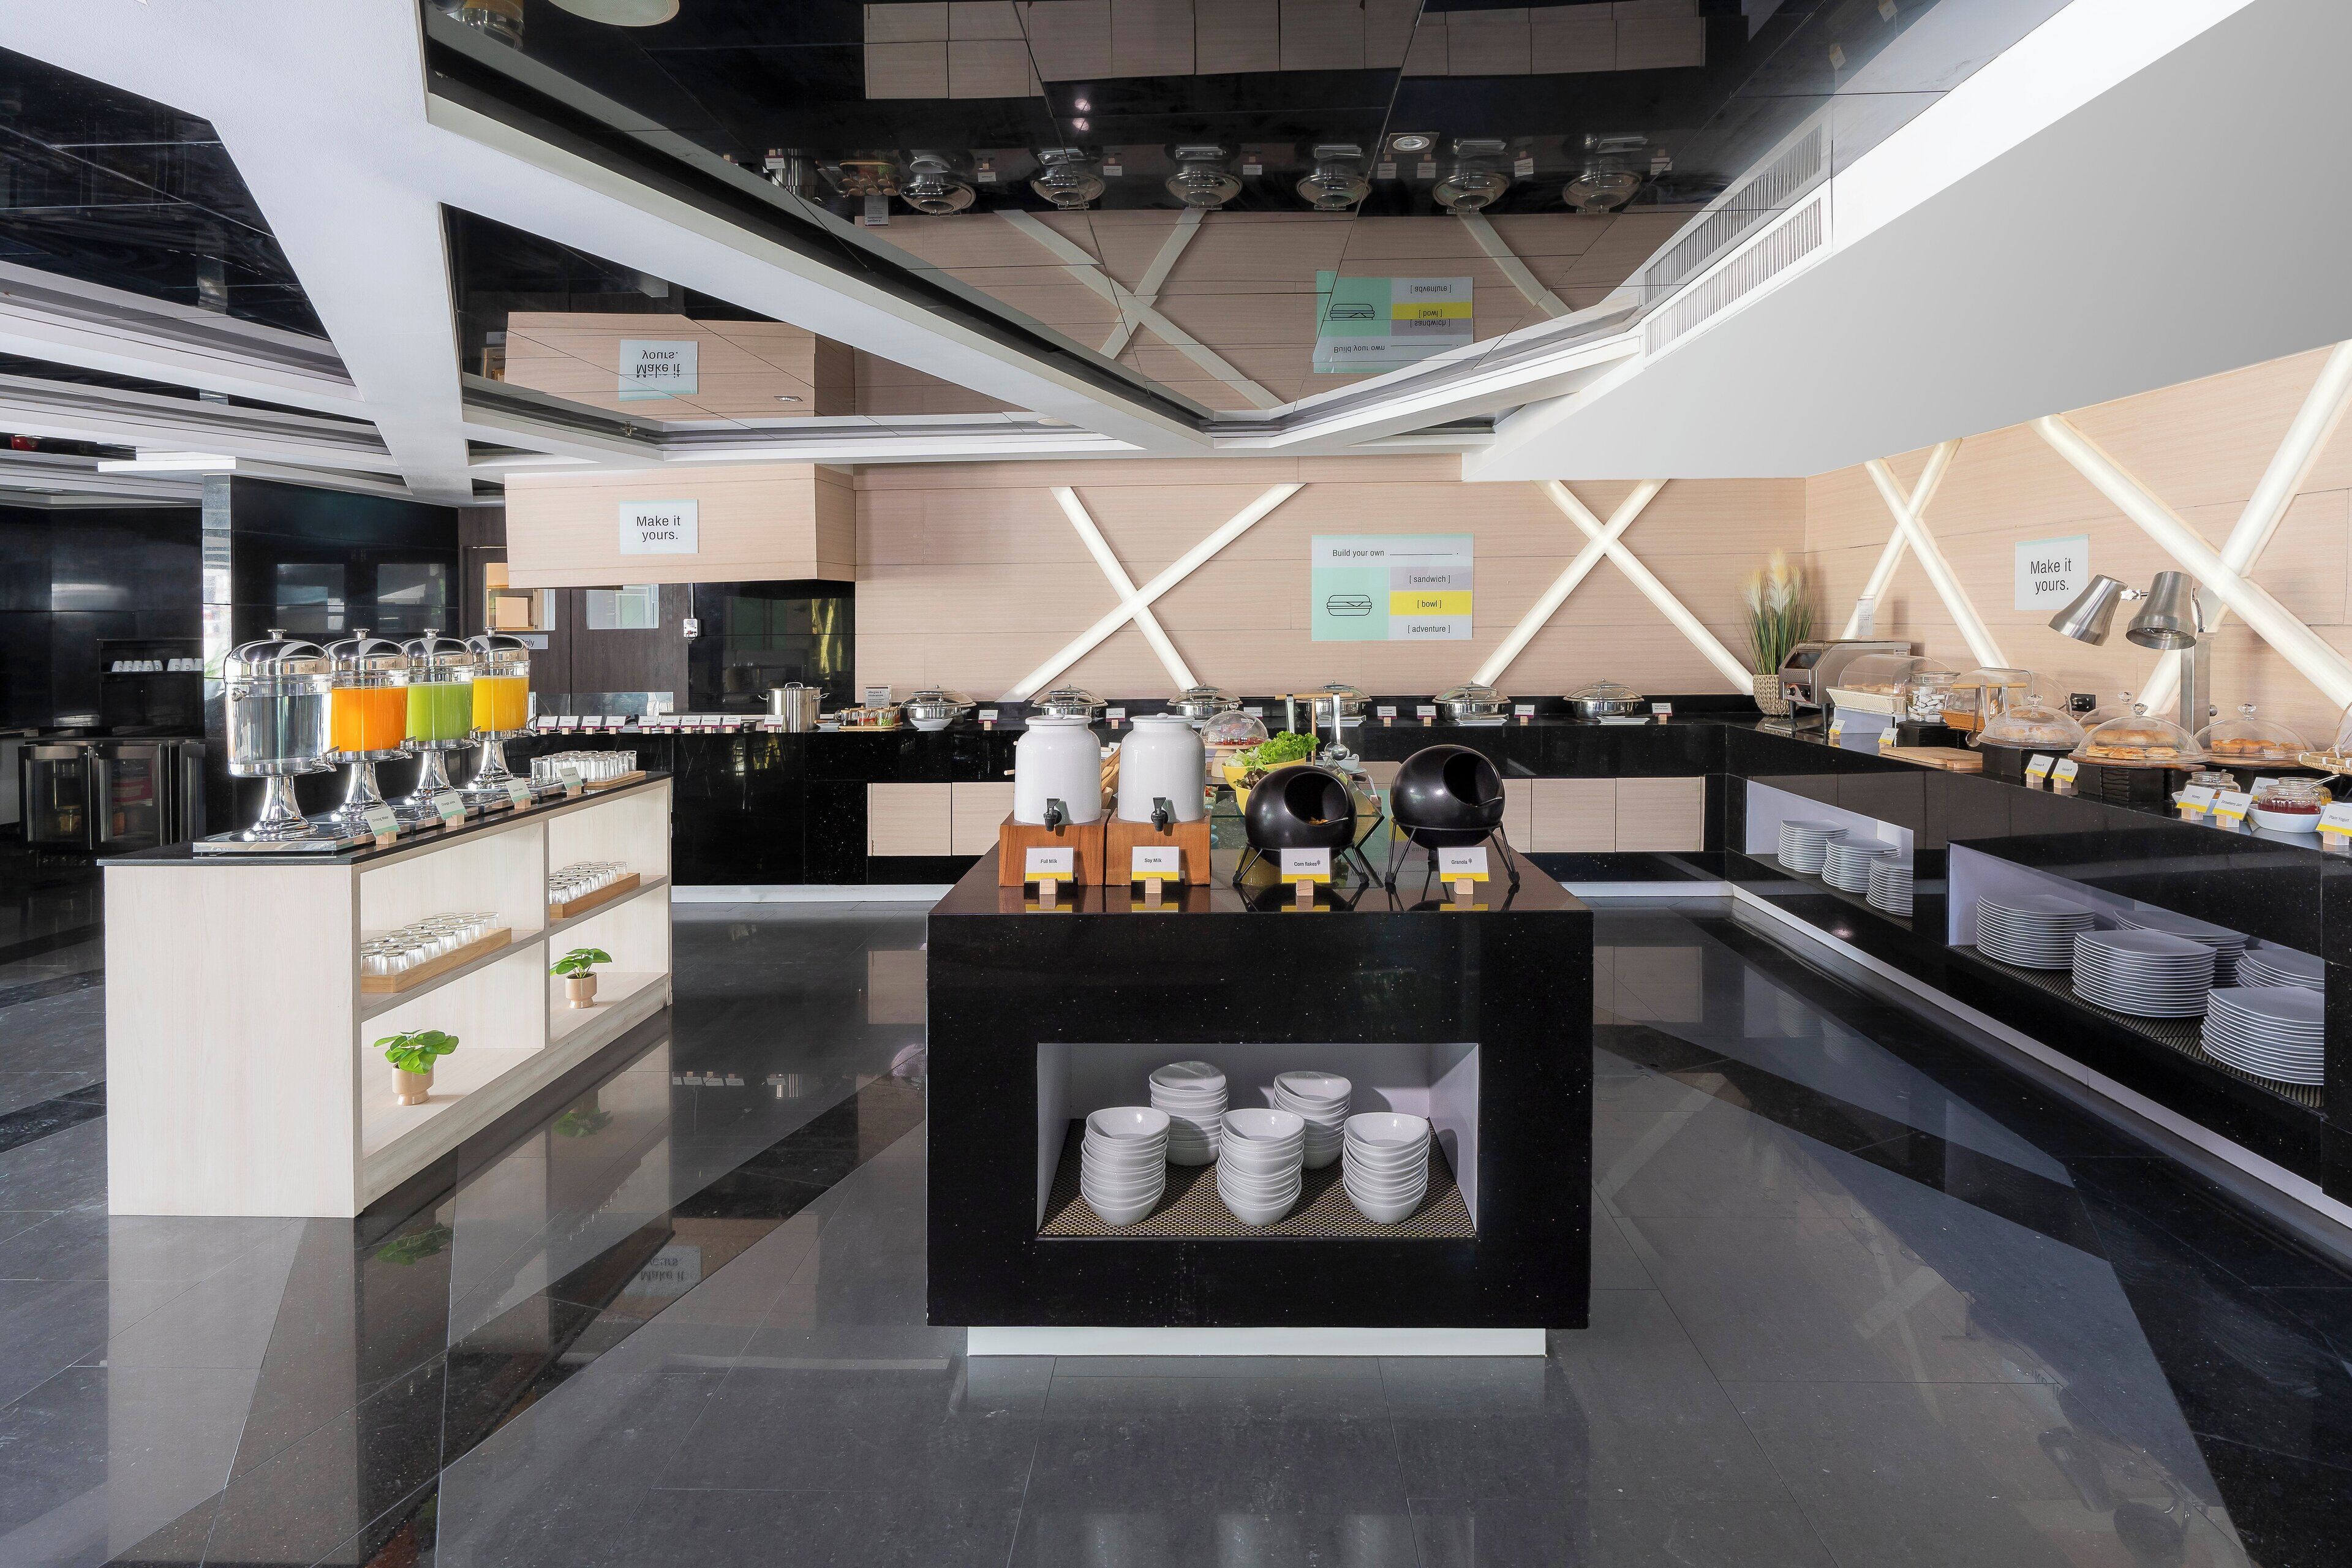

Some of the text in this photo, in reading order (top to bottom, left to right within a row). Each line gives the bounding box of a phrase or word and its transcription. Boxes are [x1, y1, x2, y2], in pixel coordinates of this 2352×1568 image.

[637, 515, 681, 527] Make it
[642, 532, 678, 543] yours.
[2030, 557, 2071, 575] Make it
[2035, 579, 2069, 595] yours.
